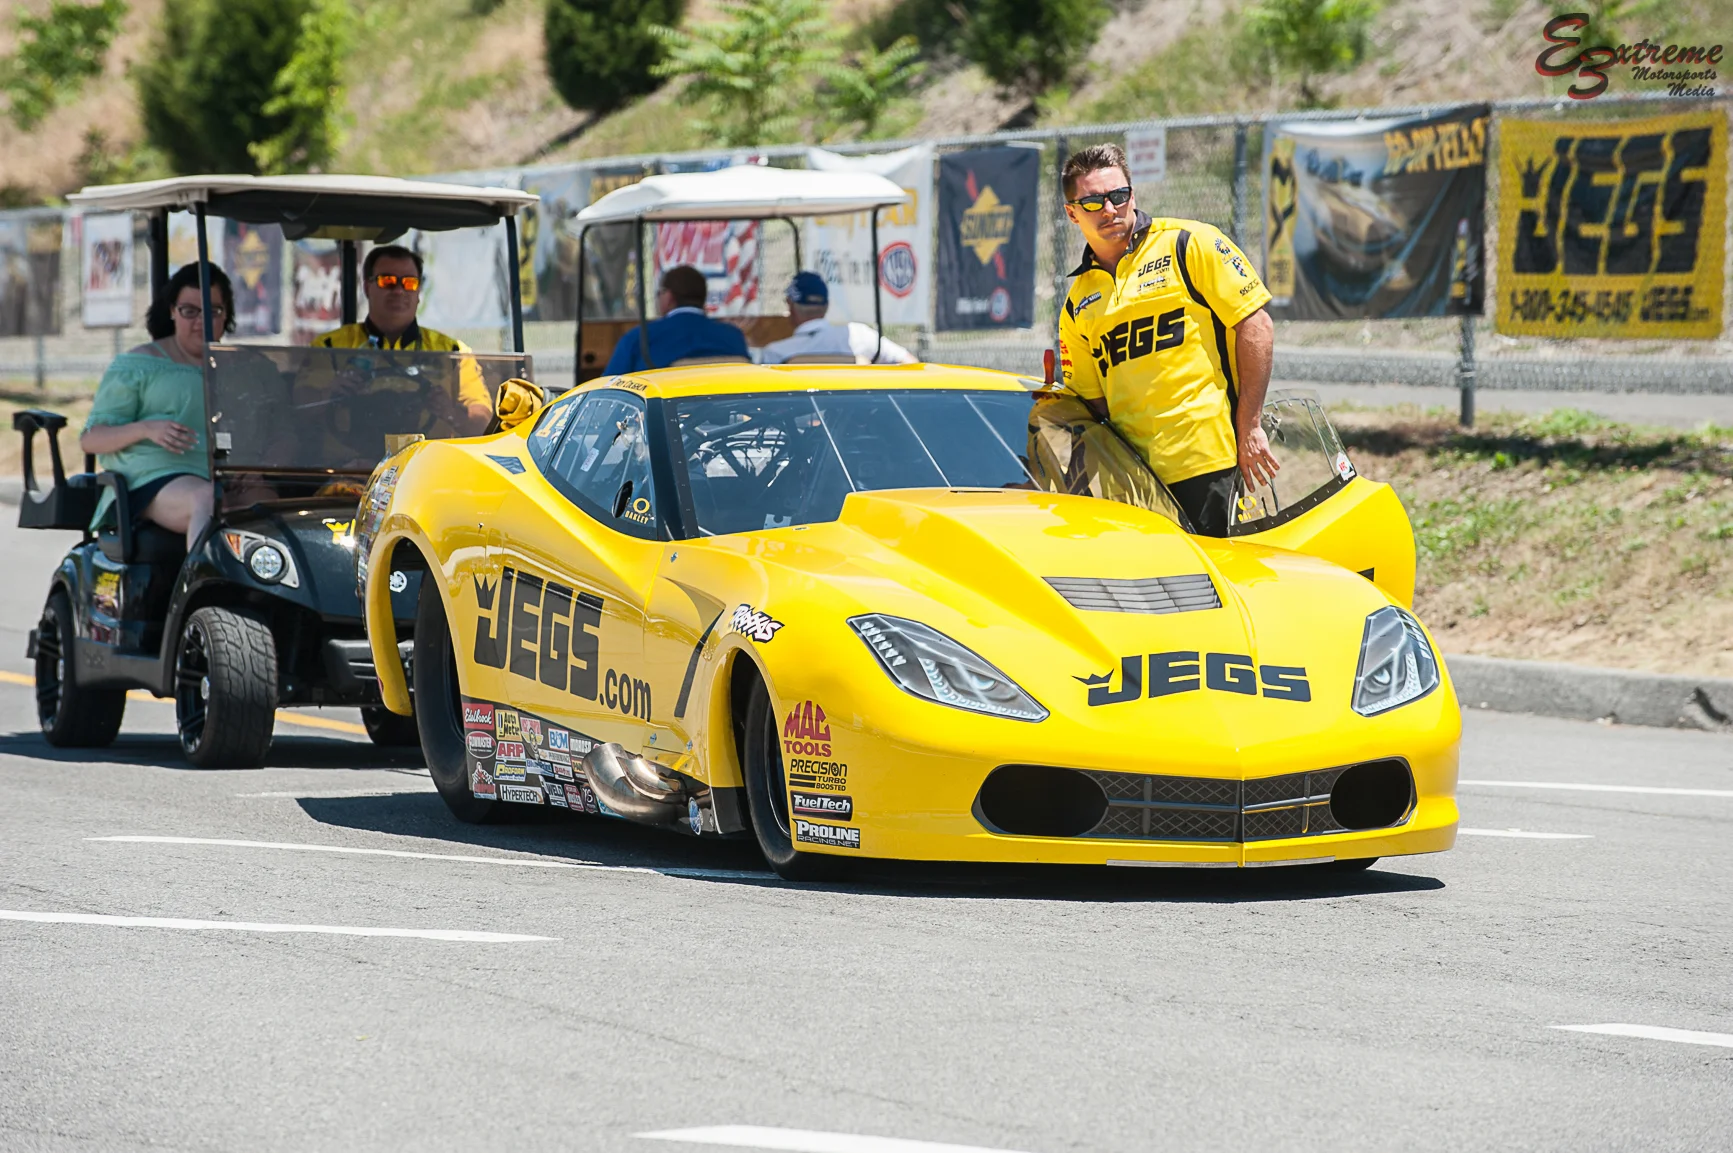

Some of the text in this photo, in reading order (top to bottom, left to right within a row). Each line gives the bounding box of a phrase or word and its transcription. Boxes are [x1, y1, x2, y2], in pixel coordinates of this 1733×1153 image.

[1513, 126, 1713, 276] JEGS
[1138, 255, 1172, 277] JEGS
[1092, 307, 1186, 378] JEGS
[625, 511, 649, 525] OAKLEY
[1087, 651, 1312, 707] JEGS
[465, 708, 492, 725] Edelbrock
[504, 713, 517, 725] Auto
[784, 700, 831, 742] MAC
[504, 723, 520, 737] Meter
[498, 743, 524, 757] ARP
[784, 740, 833, 757] TOOLS
[790, 759, 848, 778] PRECISION
[816, 783, 847, 792] BOOSTED
[817, 775, 847, 785] TURBO
[502, 785, 539, 803] HYPERTECH
[794, 794, 851, 812] FuelTech
[795, 820, 859, 841] PROLINE
